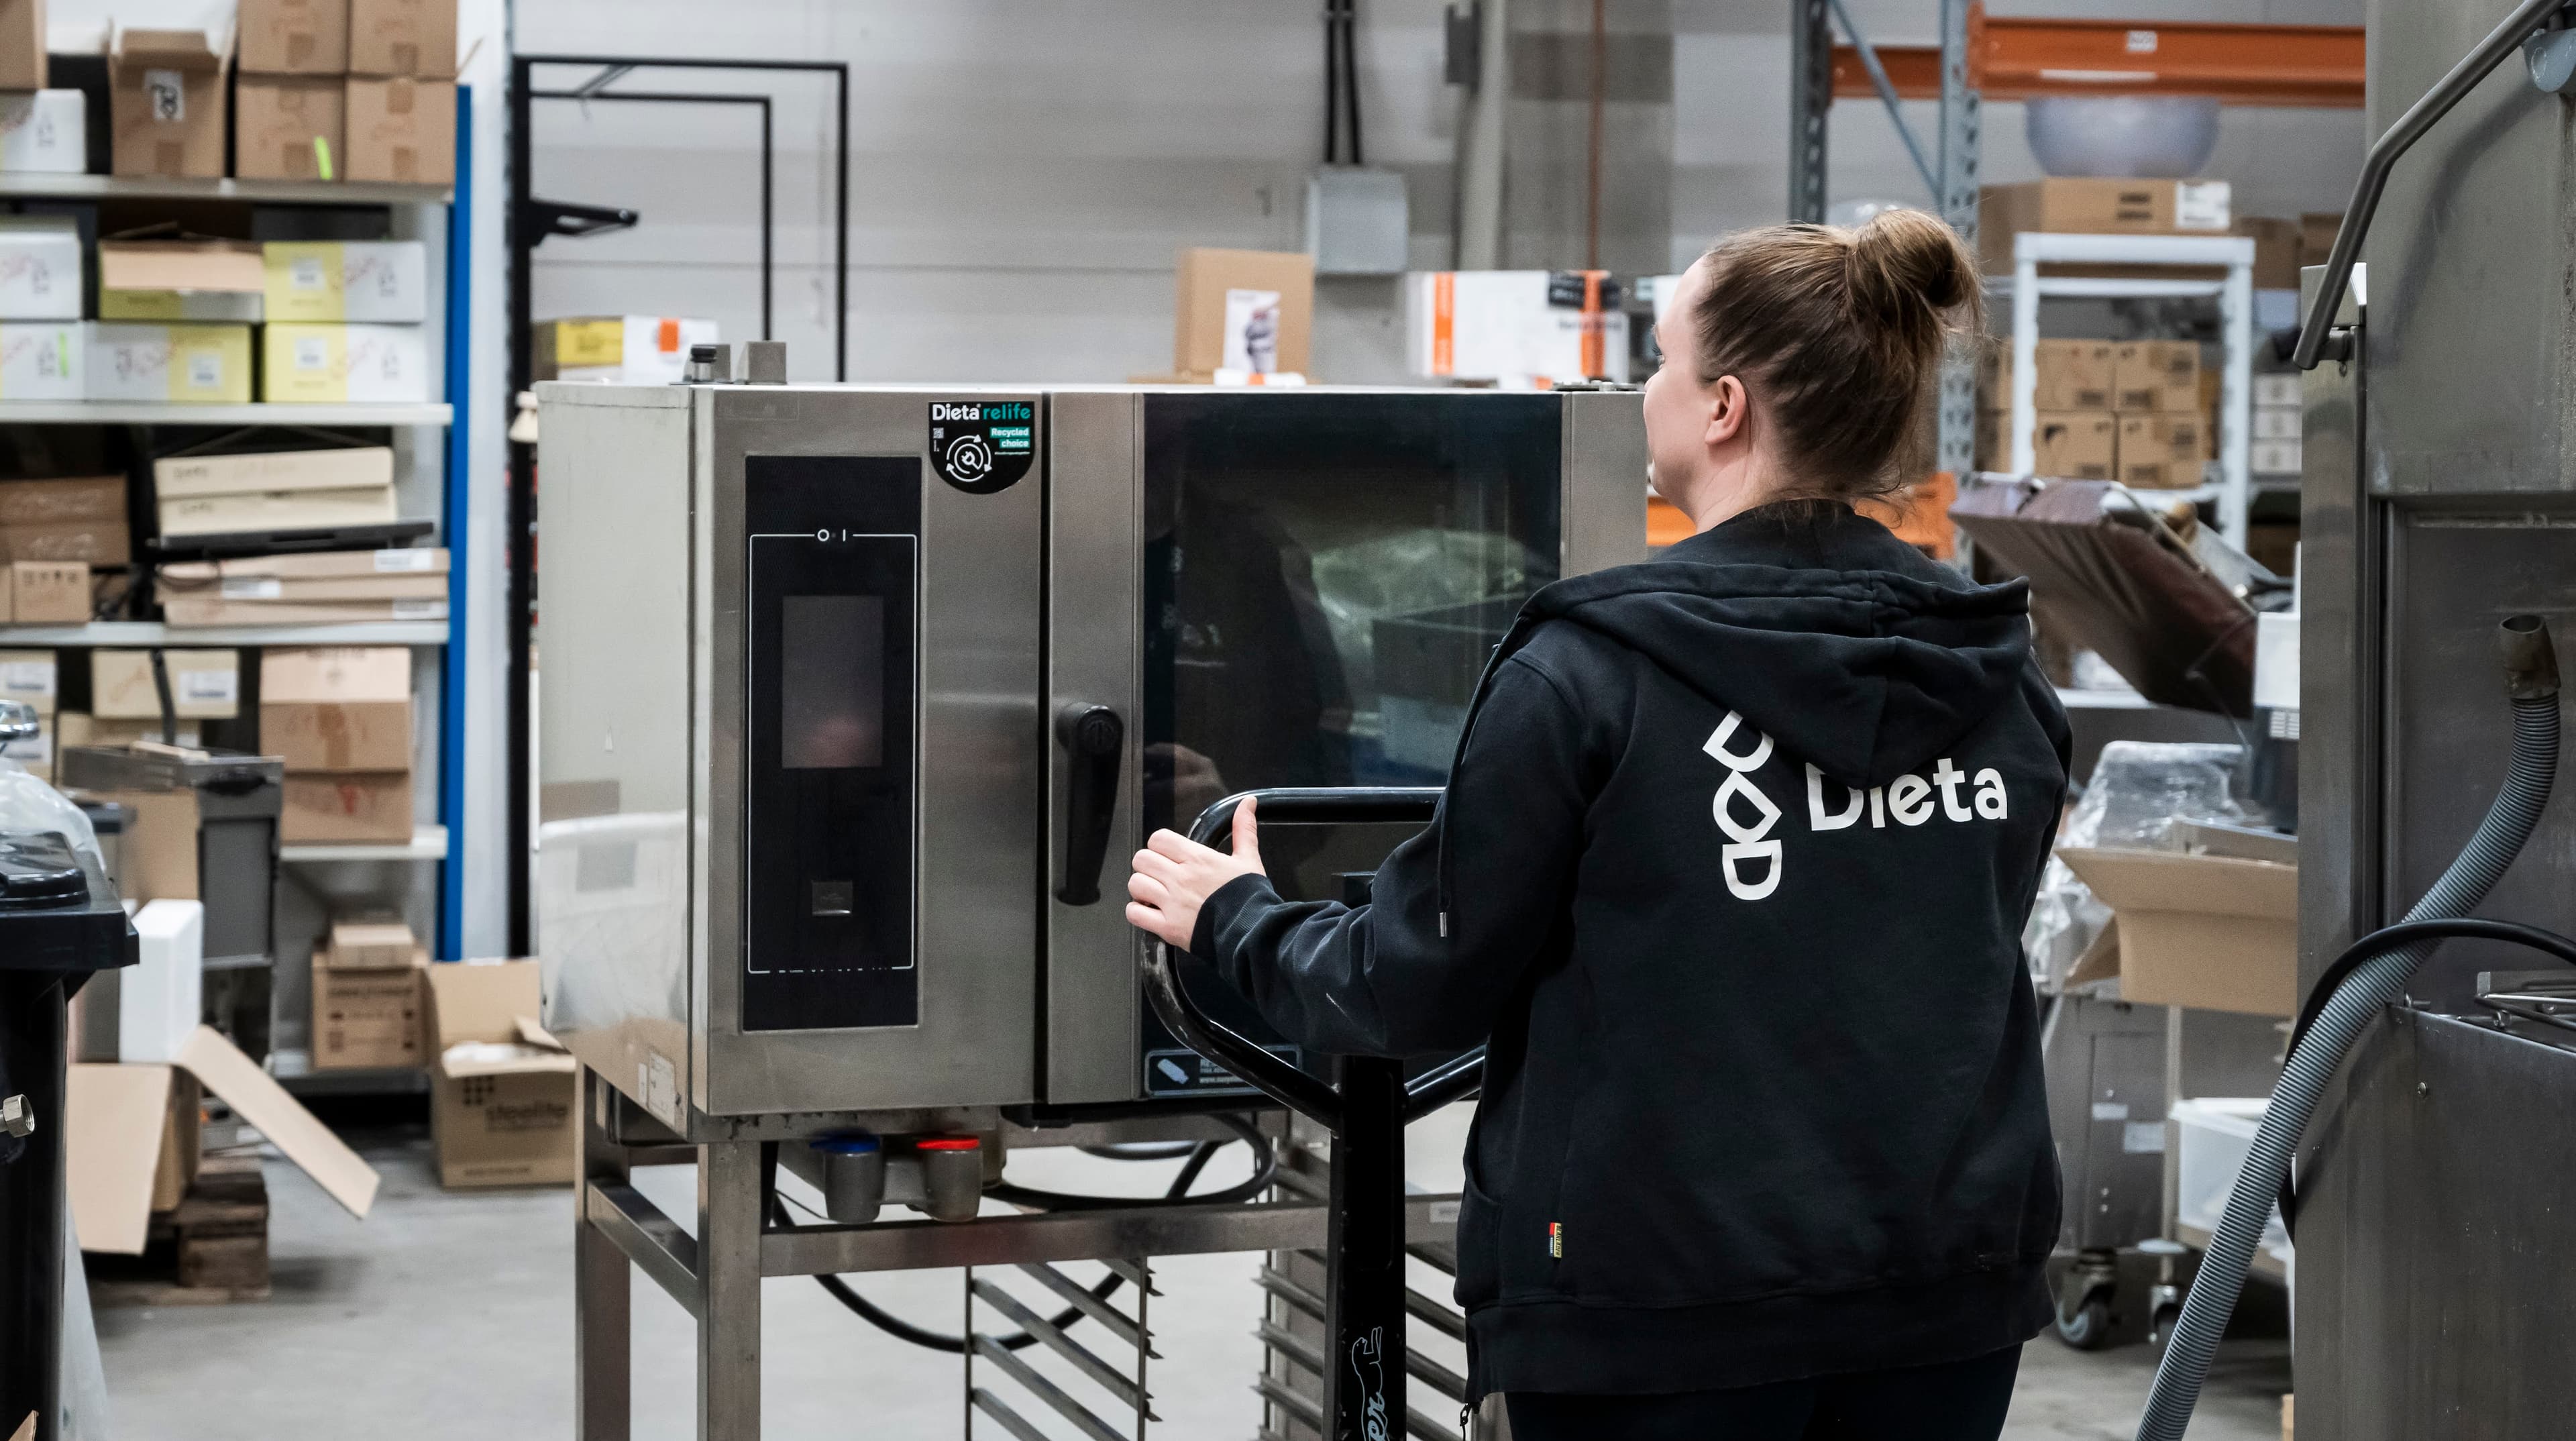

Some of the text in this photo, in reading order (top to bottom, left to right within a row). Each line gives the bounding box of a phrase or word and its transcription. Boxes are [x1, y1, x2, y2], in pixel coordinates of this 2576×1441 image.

[932, 403, 1031, 421] Dieta relife
[991, 427, 1030, 437] Recycled
[1001, 439, 1029, 447] choice
[1805, 757, 2008, 831] Dieta
